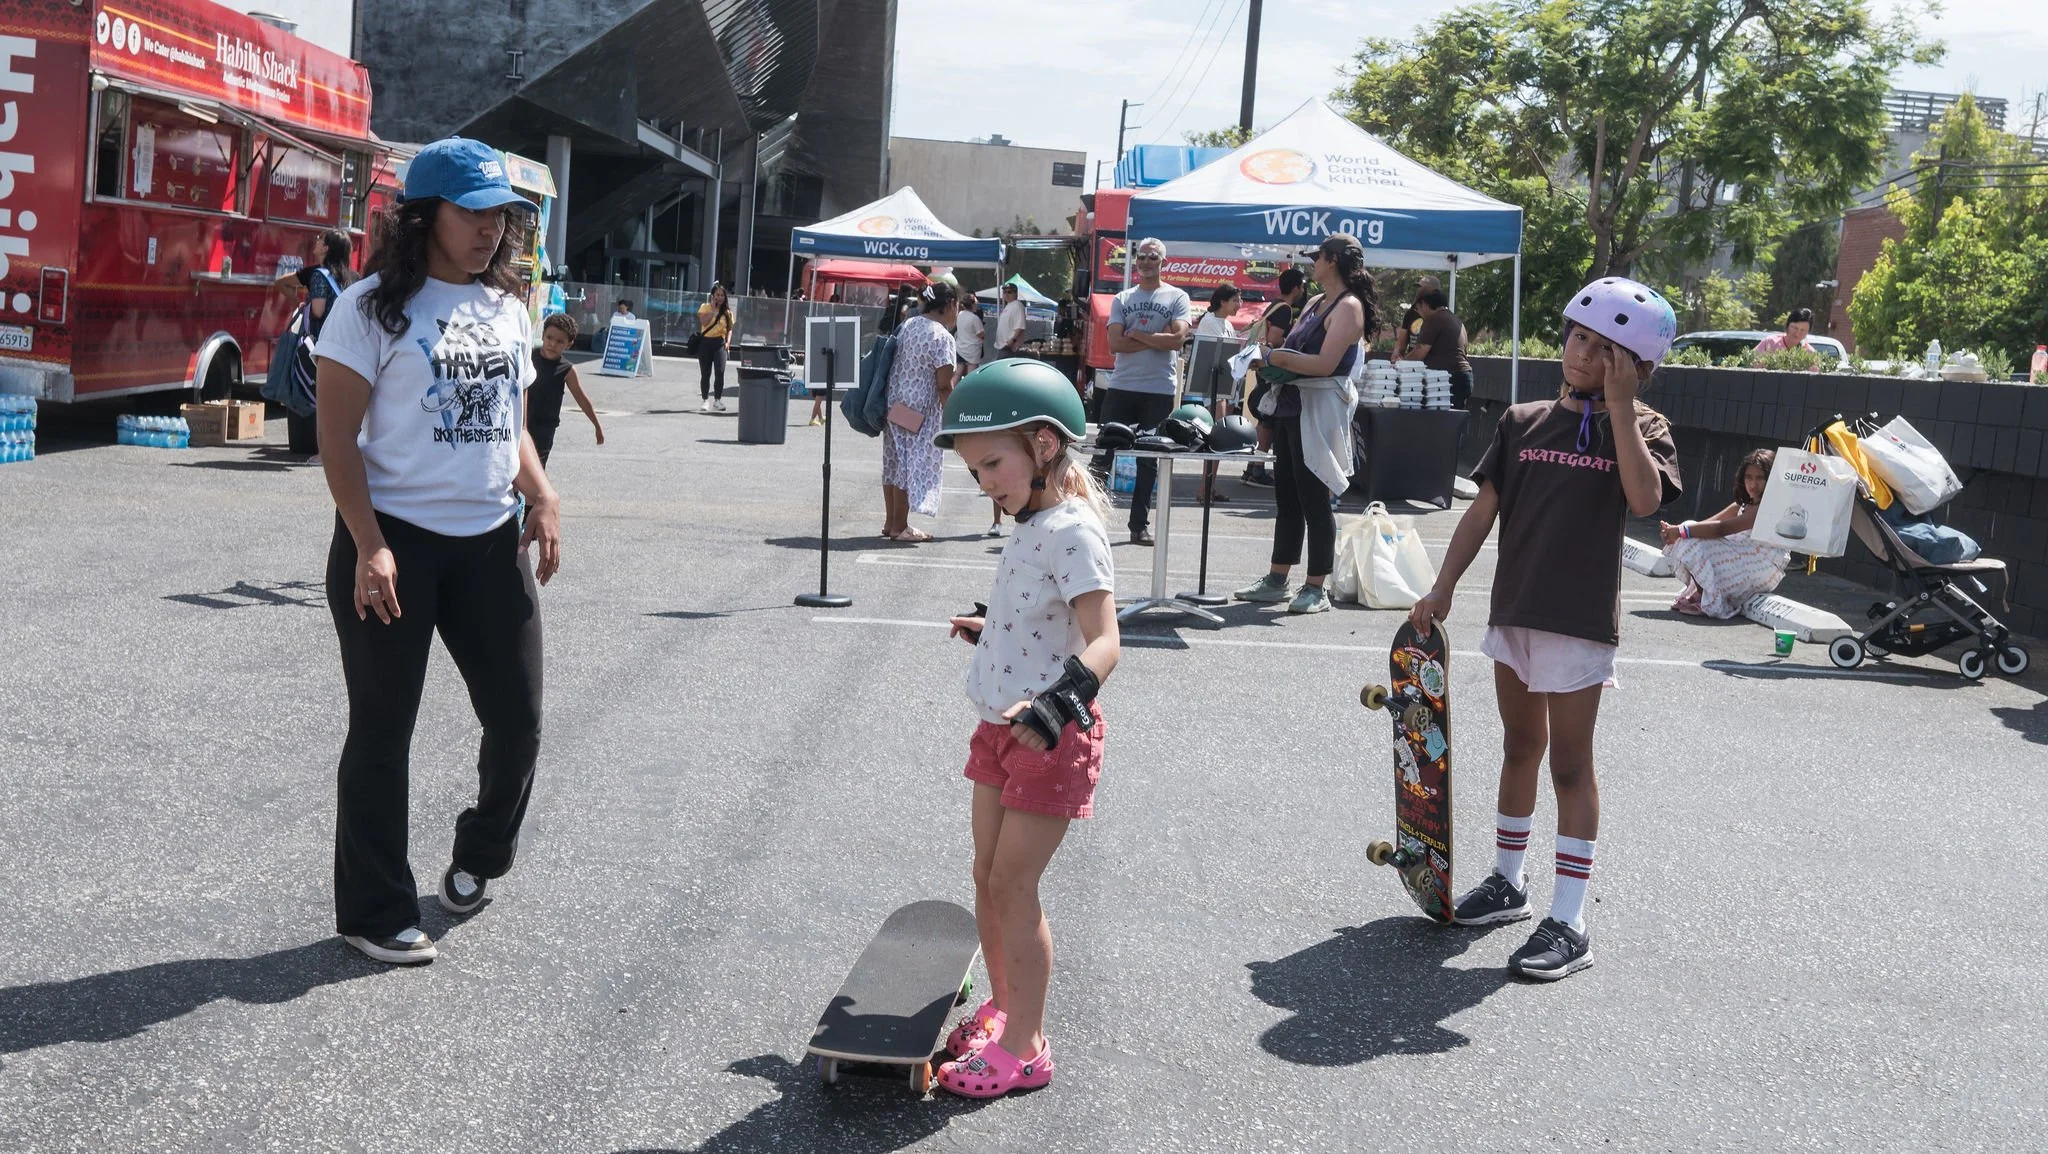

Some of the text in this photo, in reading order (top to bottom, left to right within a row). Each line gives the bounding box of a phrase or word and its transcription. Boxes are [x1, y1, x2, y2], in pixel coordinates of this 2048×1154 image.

[216, 32, 298, 89] Habibi Shack
[1325, 154, 1379, 165] World
[1328, 165, 1399, 177] Central
[1329, 175, 1406, 187] Kitchen
[1264, 210, 1384, 245] WCK.org
[864, 240, 929, 259] WCK.org
[1160, 259, 1238, 276] uesatacos
[1122, 302, 1172, 319] PALISADES
[432, 348, 519, 380] HAVEN
[959, 411, 992, 422] thousand
[1519, 448, 1618, 472] SKATEGOAT
[1784, 472, 1827, 487] SUPERGA
